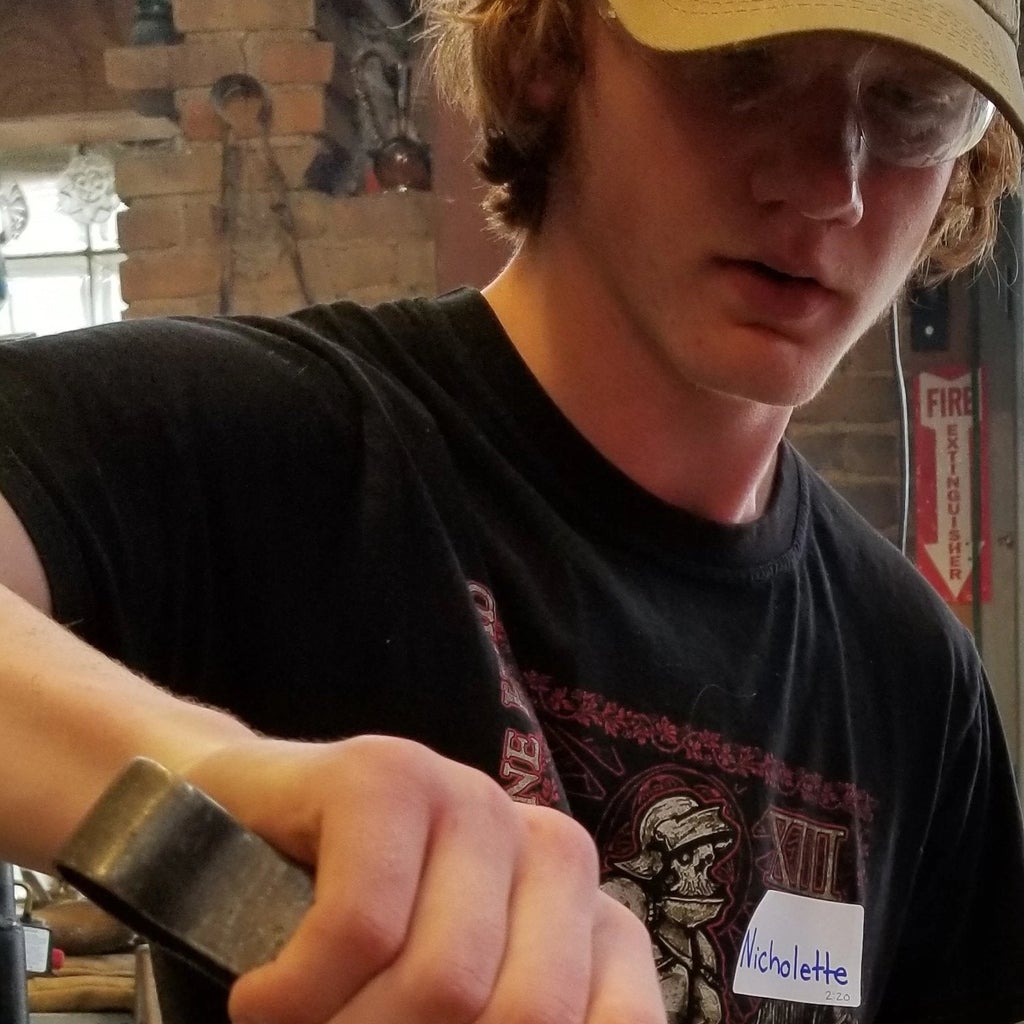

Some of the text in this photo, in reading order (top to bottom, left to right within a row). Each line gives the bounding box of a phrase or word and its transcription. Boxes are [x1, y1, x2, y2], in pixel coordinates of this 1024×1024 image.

[926, 387, 974, 417] FIRE
[946, 424, 962, 580] EXTINGUISHER
[740, 927, 848, 985] Nicholette
